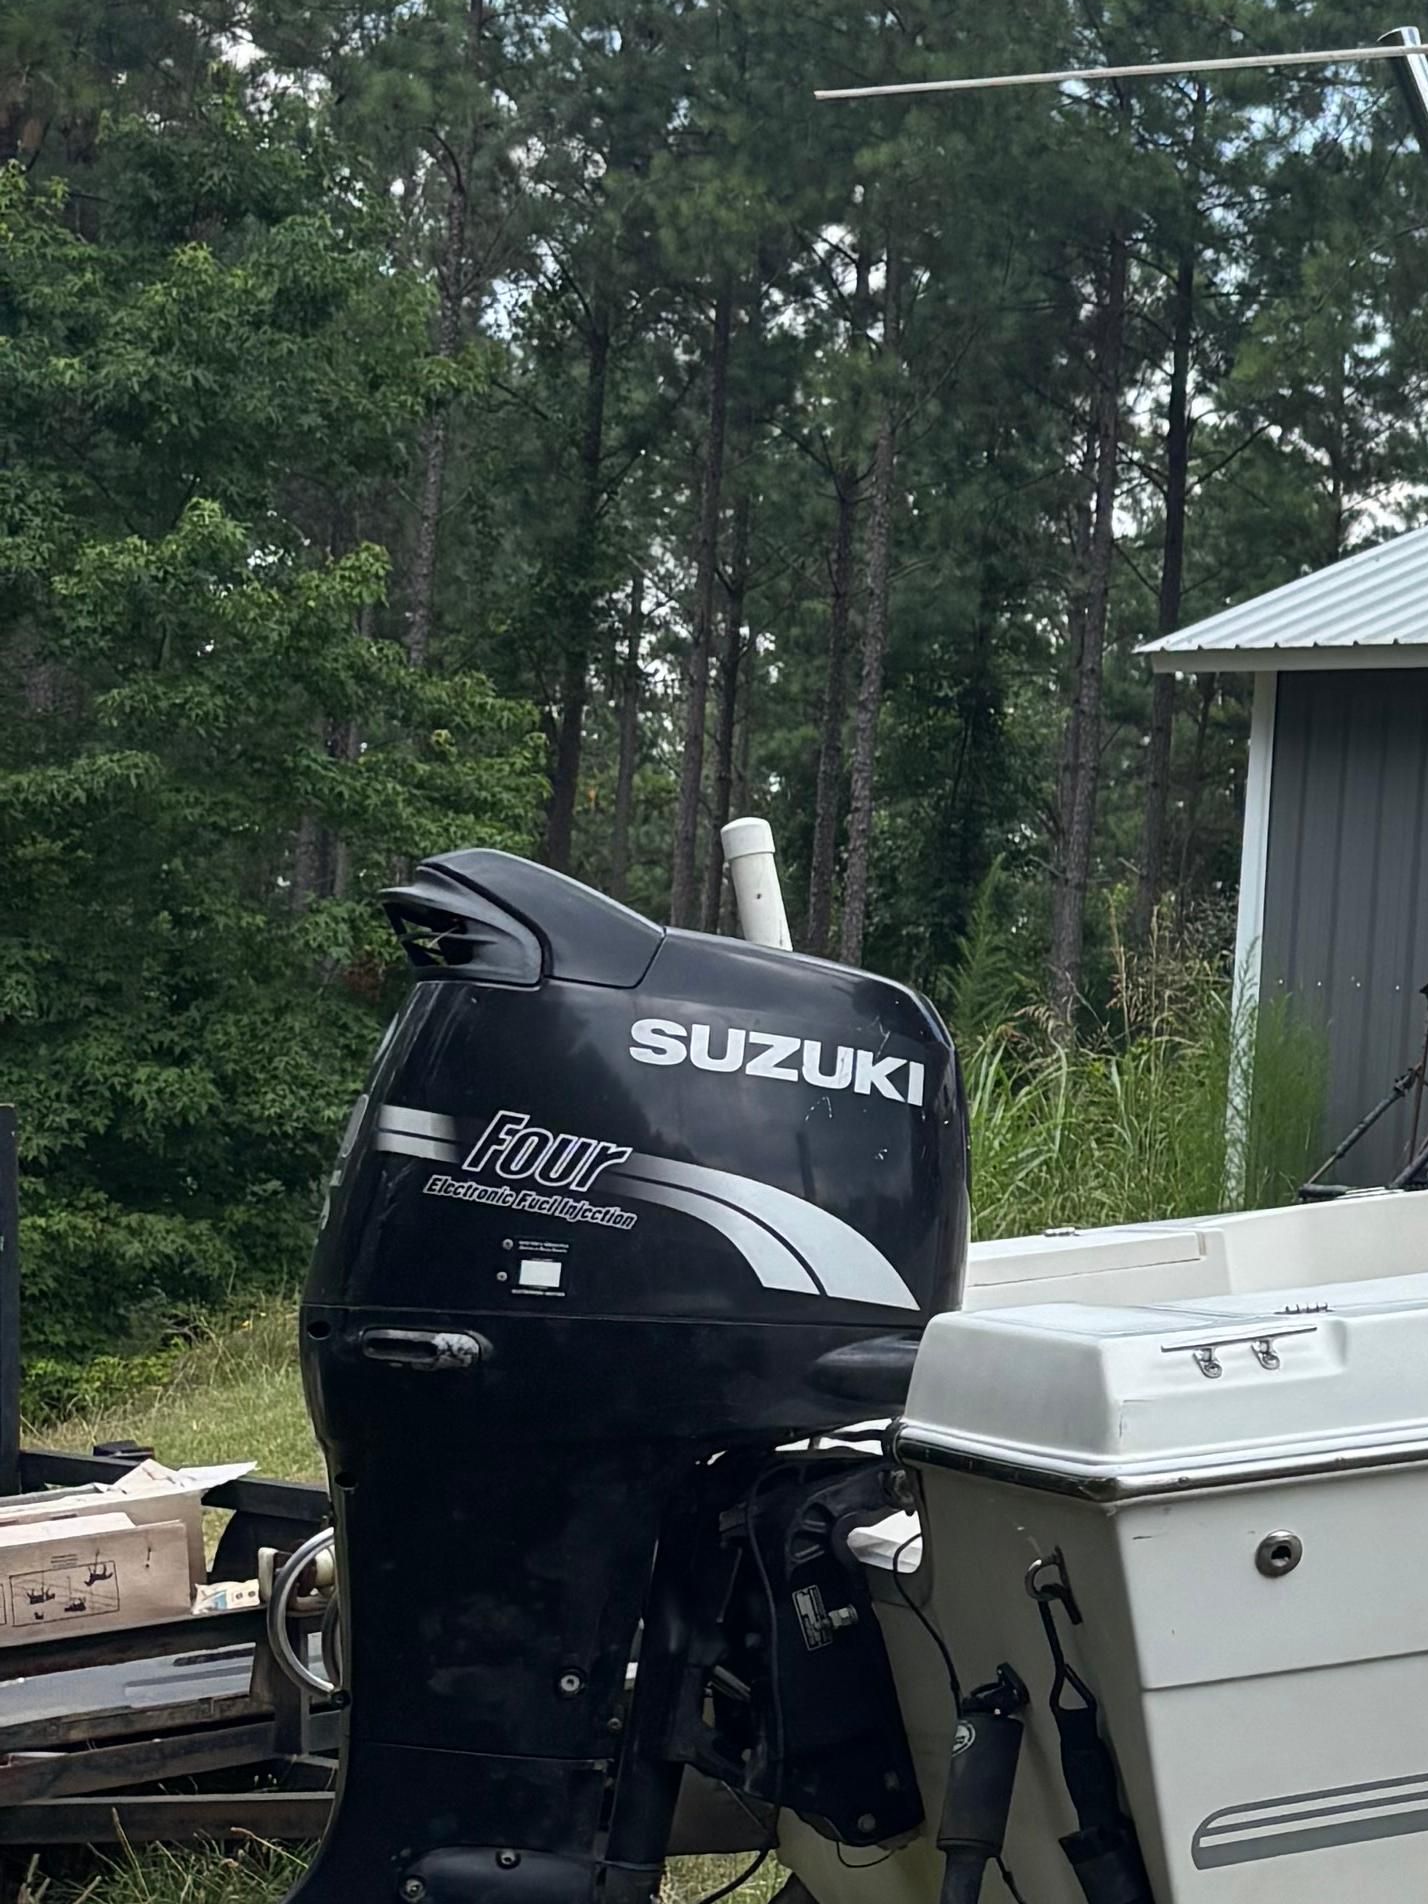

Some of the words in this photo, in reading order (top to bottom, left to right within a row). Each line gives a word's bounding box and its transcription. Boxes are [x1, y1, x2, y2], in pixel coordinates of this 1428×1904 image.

[629, 1018, 925, 1107] SUZUKI
[461, 1110, 633, 1193] Four
[422, 1174, 516, 1207] Electronic
[512, 1190, 557, 1216] Fuel
[554, 1196, 638, 1230] Injection
